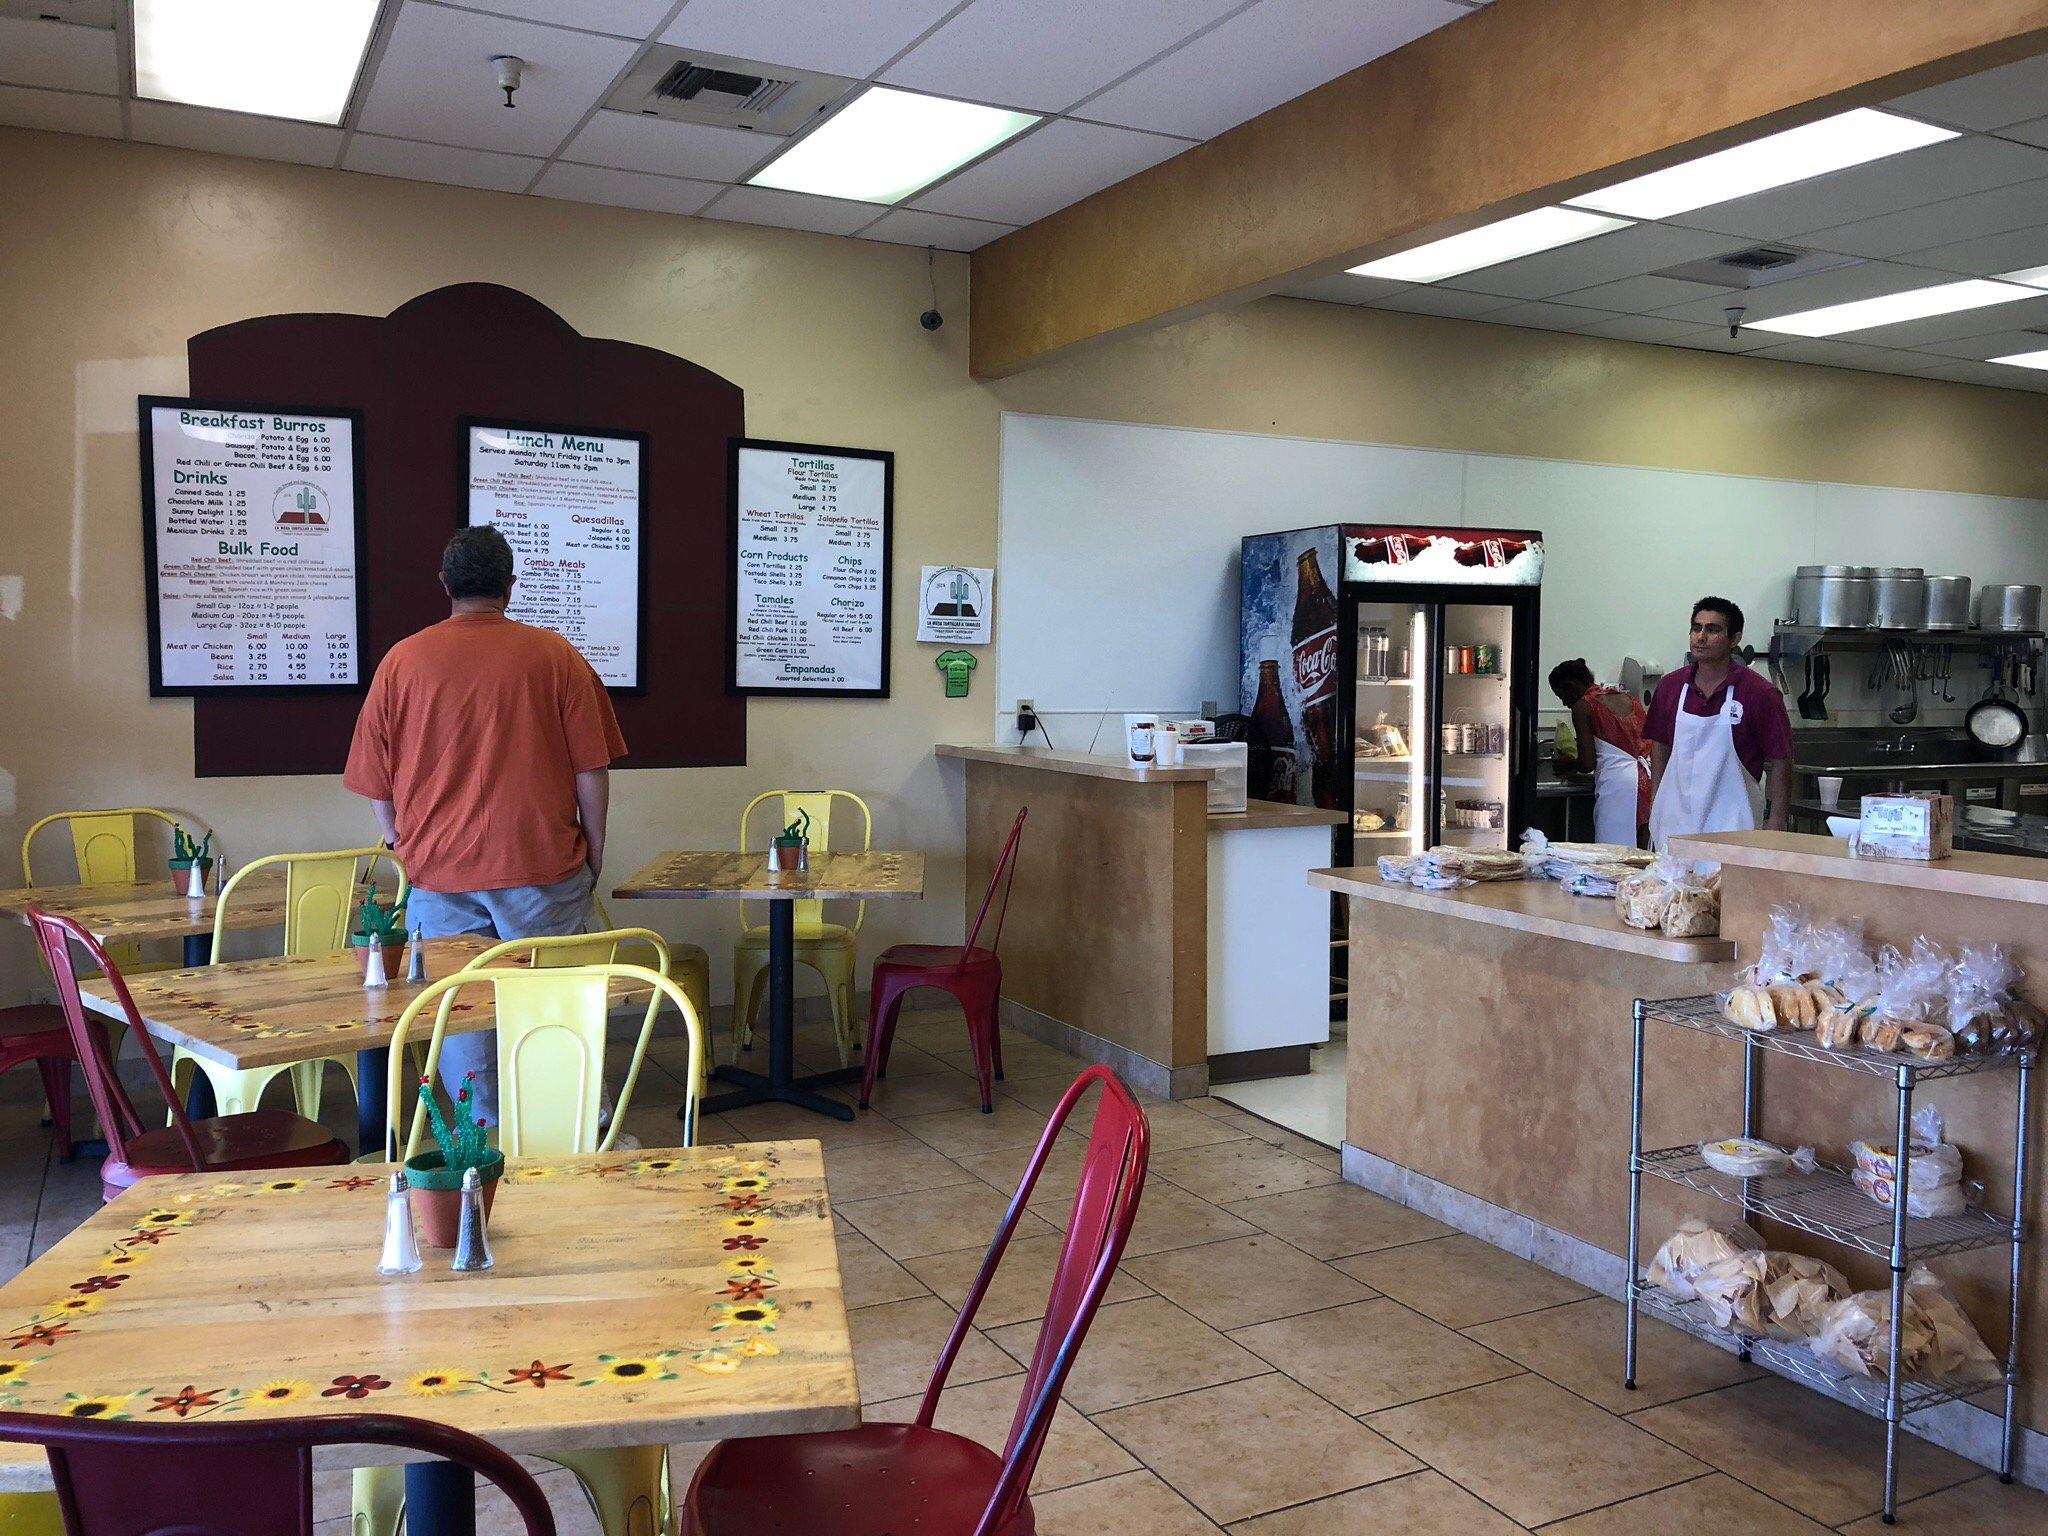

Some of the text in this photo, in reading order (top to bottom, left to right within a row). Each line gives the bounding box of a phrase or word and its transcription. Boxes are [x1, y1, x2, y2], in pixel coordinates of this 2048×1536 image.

[180, 411, 326, 433] Breakfast Burros
[296, 435, 309, 444] Egg
[562, 436, 604, 453] Menu
[296, 445, 309, 453] Egg
[261, 453, 285, 461] Potato
[296, 454, 309, 463] Egg
[509, 449, 536, 458] Monday
[558, 453, 581, 462] Friday
[616, 457, 630, 466] 3pm
[296, 464, 309, 473] Egg
[514, 459, 548, 468] Saturday
[584, 464, 598, 472] 2pm
[791, 458, 835, 471] Tortillas
[174, 469, 228, 485] Drinks
[788, 468, 838, 479] Flour Tortillas
[174, 488, 202, 496] Canned
[172, 508, 194, 516] Sunny
[197, 509, 224, 517] Delight
[798, 504, 816, 512] Large
[495, 509, 527, 519] Burros
[572, 514, 625, 525] Quesadillas
[747, 509, 804, 520] Wheat Tortillas
[168, 517, 197, 525] Bottled
[818, 515, 848, 524] Jalapeño
[851, 516, 879, 526] Tortillas
[218, 541, 298, 556] Bulk Food
[740, 550, 808, 562] Corn Products
[838, 556, 862, 567] Chips
[524, 558, 586, 569] Combo Meals
[848, 567, 862, 575] Chips
[755, 594, 794, 604] Tamales
[831, 597, 865, 607] Chorizo
[817, 612, 837, 620] Regular
[325, 633, 346, 641] Large
[784, 663, 836, 675] Empanadas
